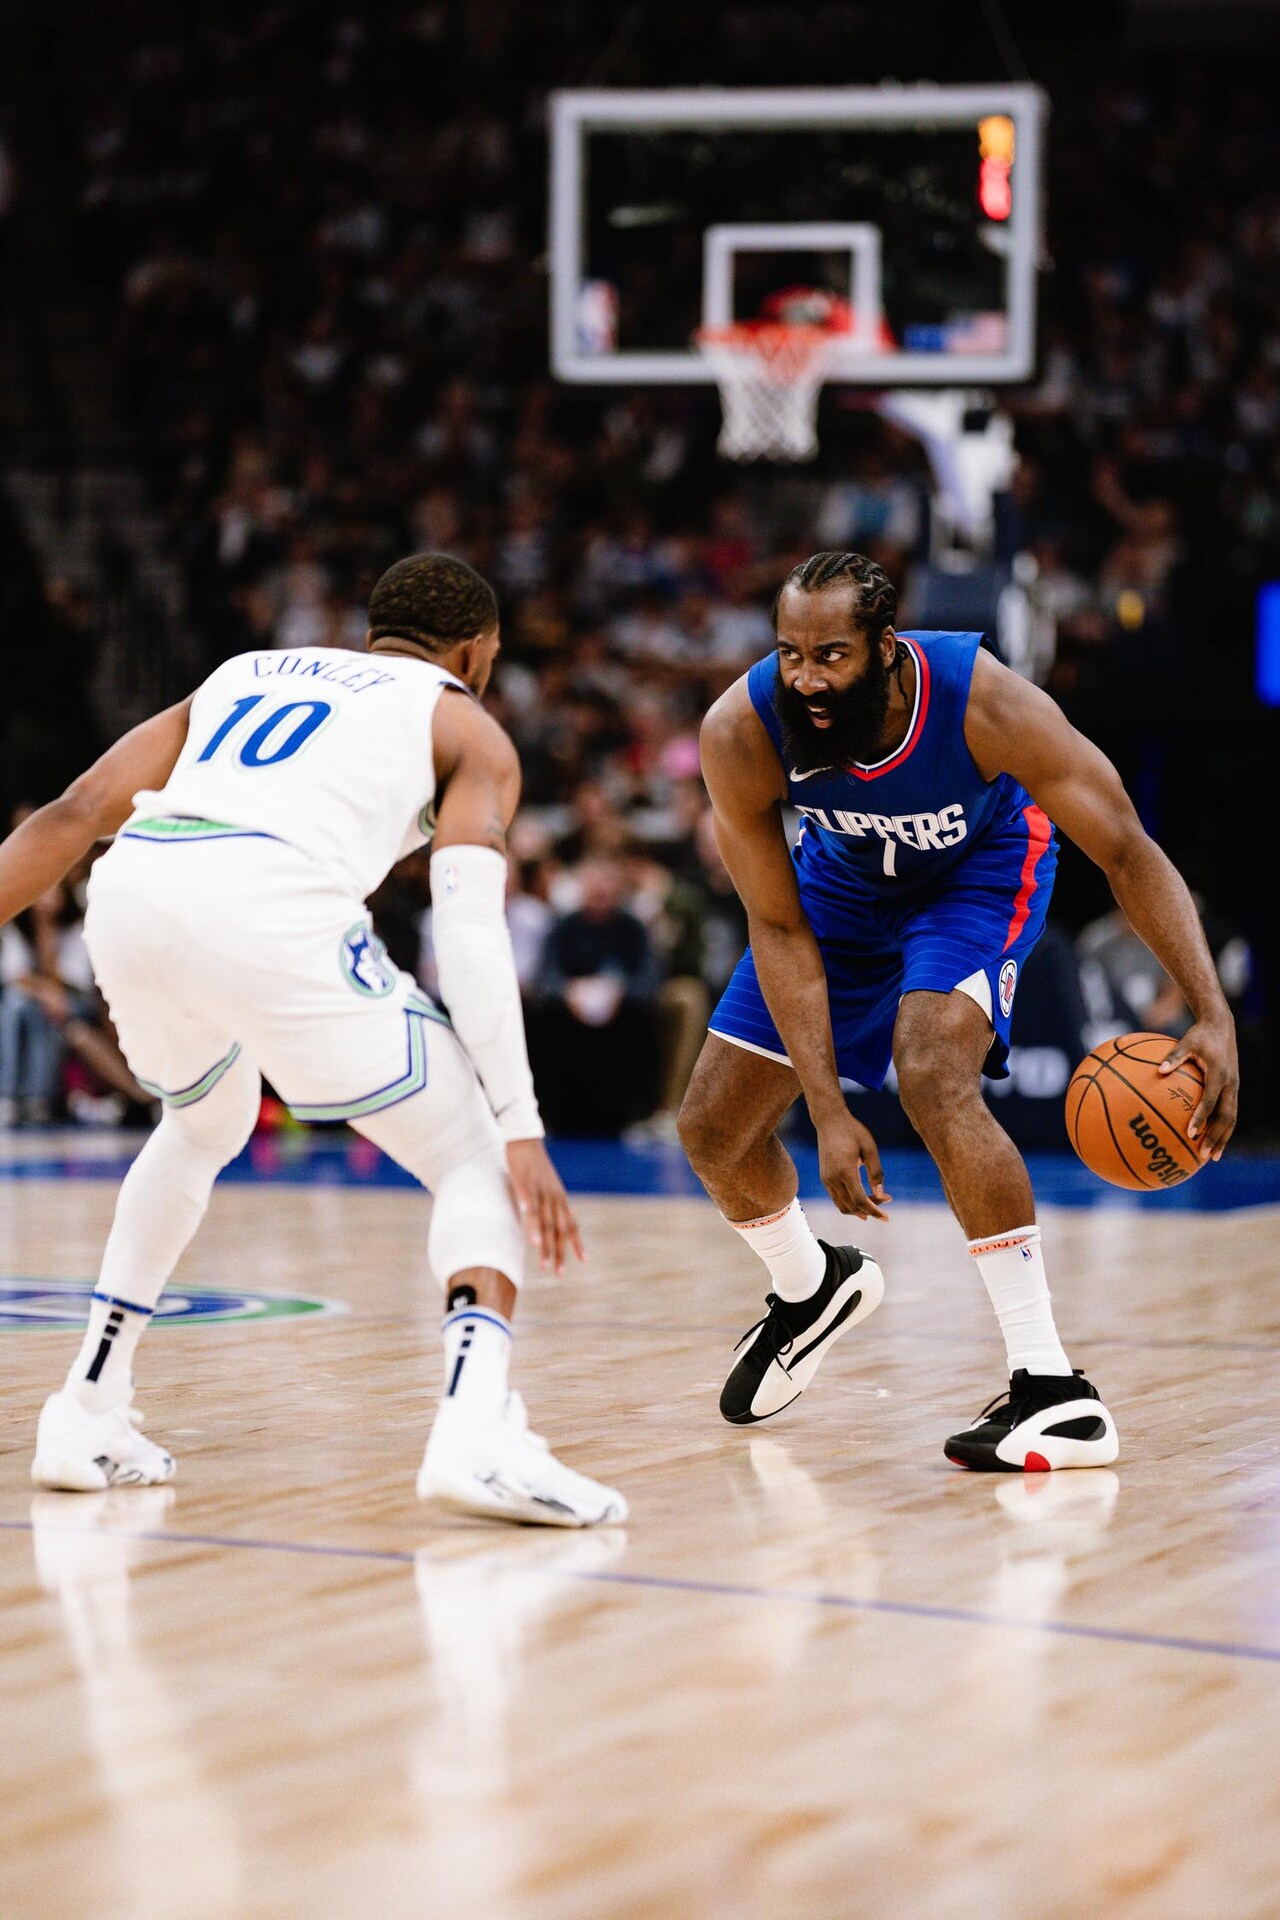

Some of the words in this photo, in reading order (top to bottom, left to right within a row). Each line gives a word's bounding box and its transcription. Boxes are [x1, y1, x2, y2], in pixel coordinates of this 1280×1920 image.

[253, 654, 396, 694] CONLEY
[197, 693, 332, 768] 10
[1129, 1110, 1190, 1186] Wilson
